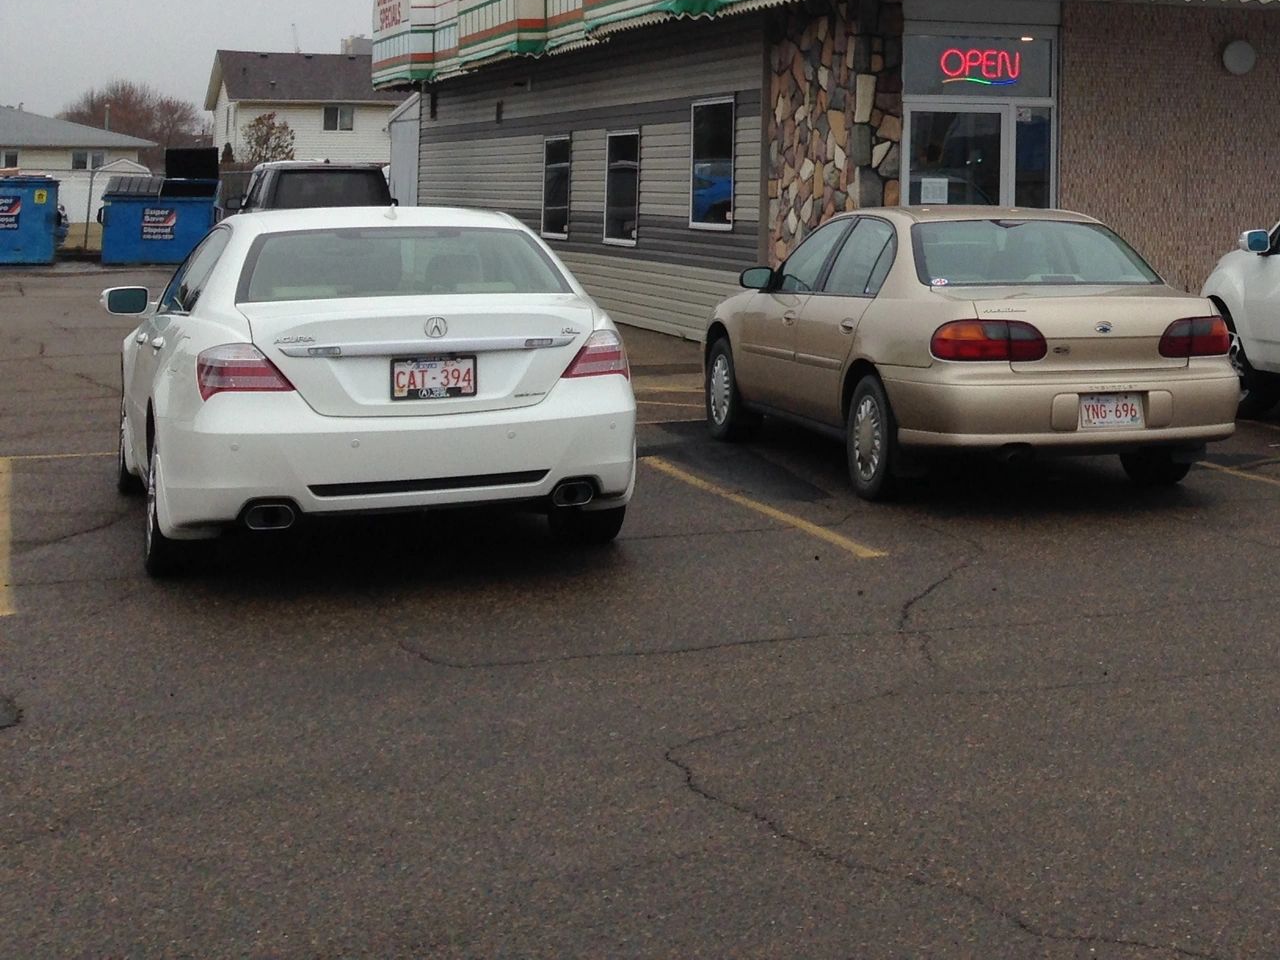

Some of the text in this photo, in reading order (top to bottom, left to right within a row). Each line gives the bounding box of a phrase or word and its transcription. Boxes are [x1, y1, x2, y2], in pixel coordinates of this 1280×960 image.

[940, 48, 1021, 78] OPEN
[396, 367, 472, 389] CAT-394
[1084, 402, 1137, 419] YNG-696
